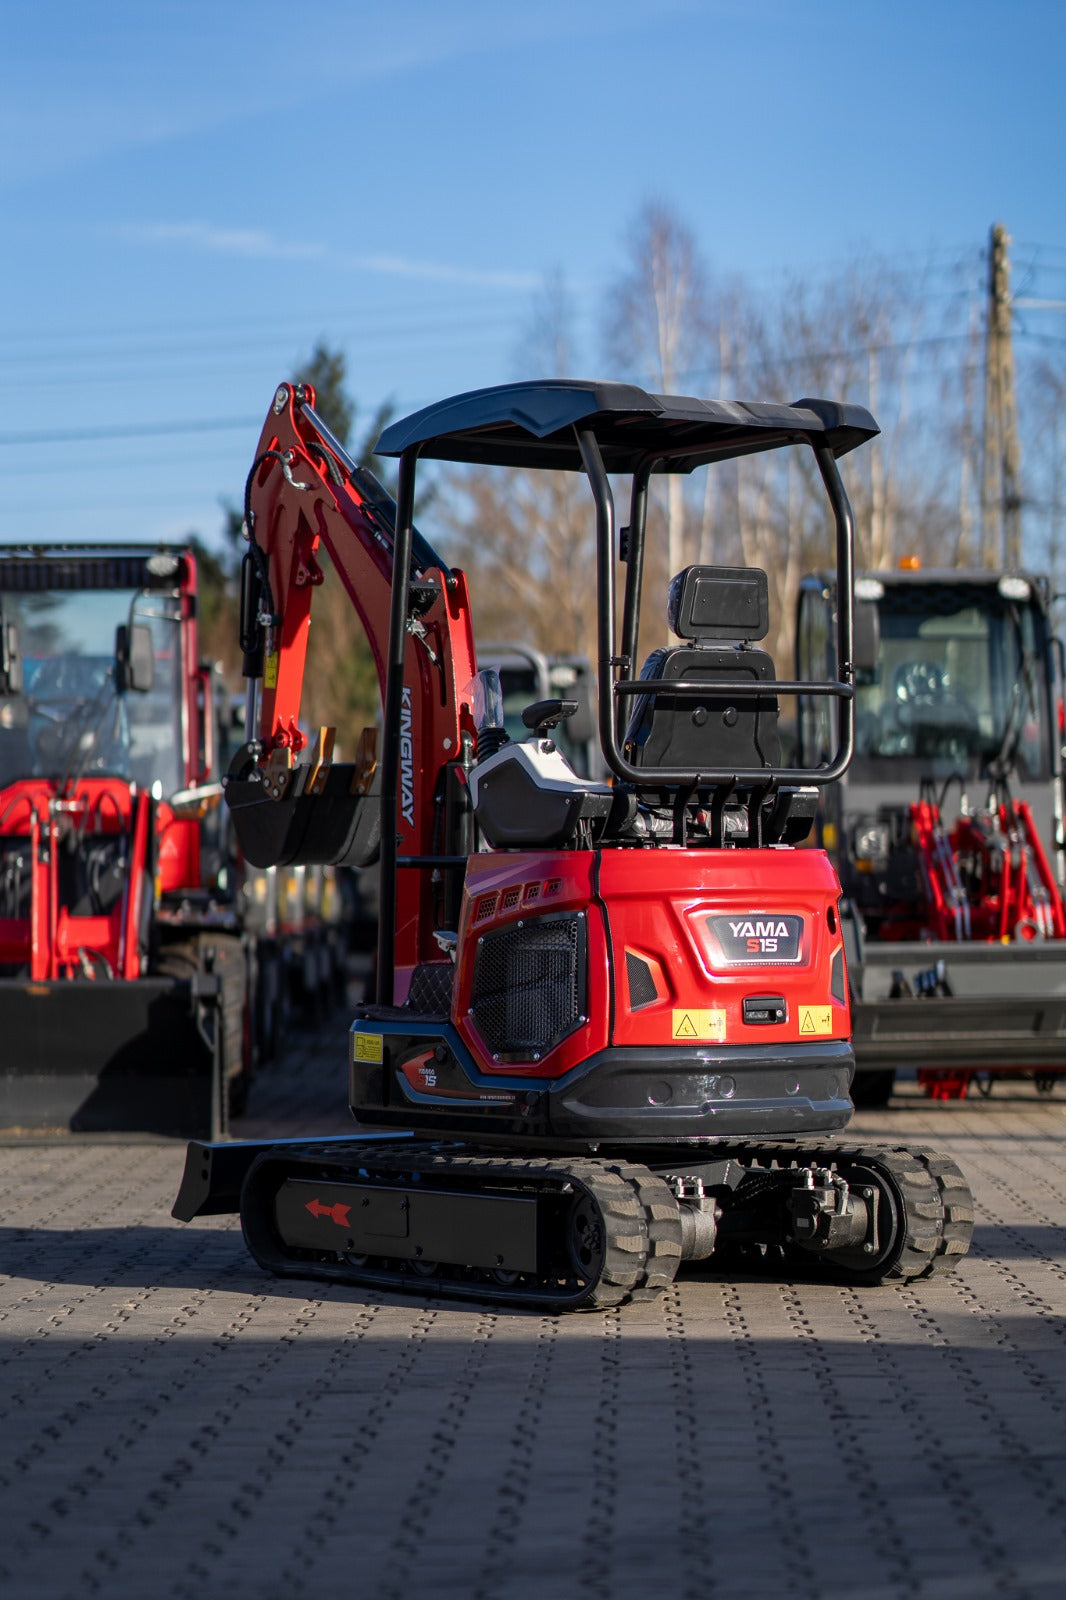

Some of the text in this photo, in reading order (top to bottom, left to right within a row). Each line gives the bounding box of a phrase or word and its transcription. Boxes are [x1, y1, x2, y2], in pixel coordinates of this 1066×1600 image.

[401, 686, 414, 827] KINGWAY
[728, 921, 789, 937] YAMA
[746, 938, 778, 953] S15
